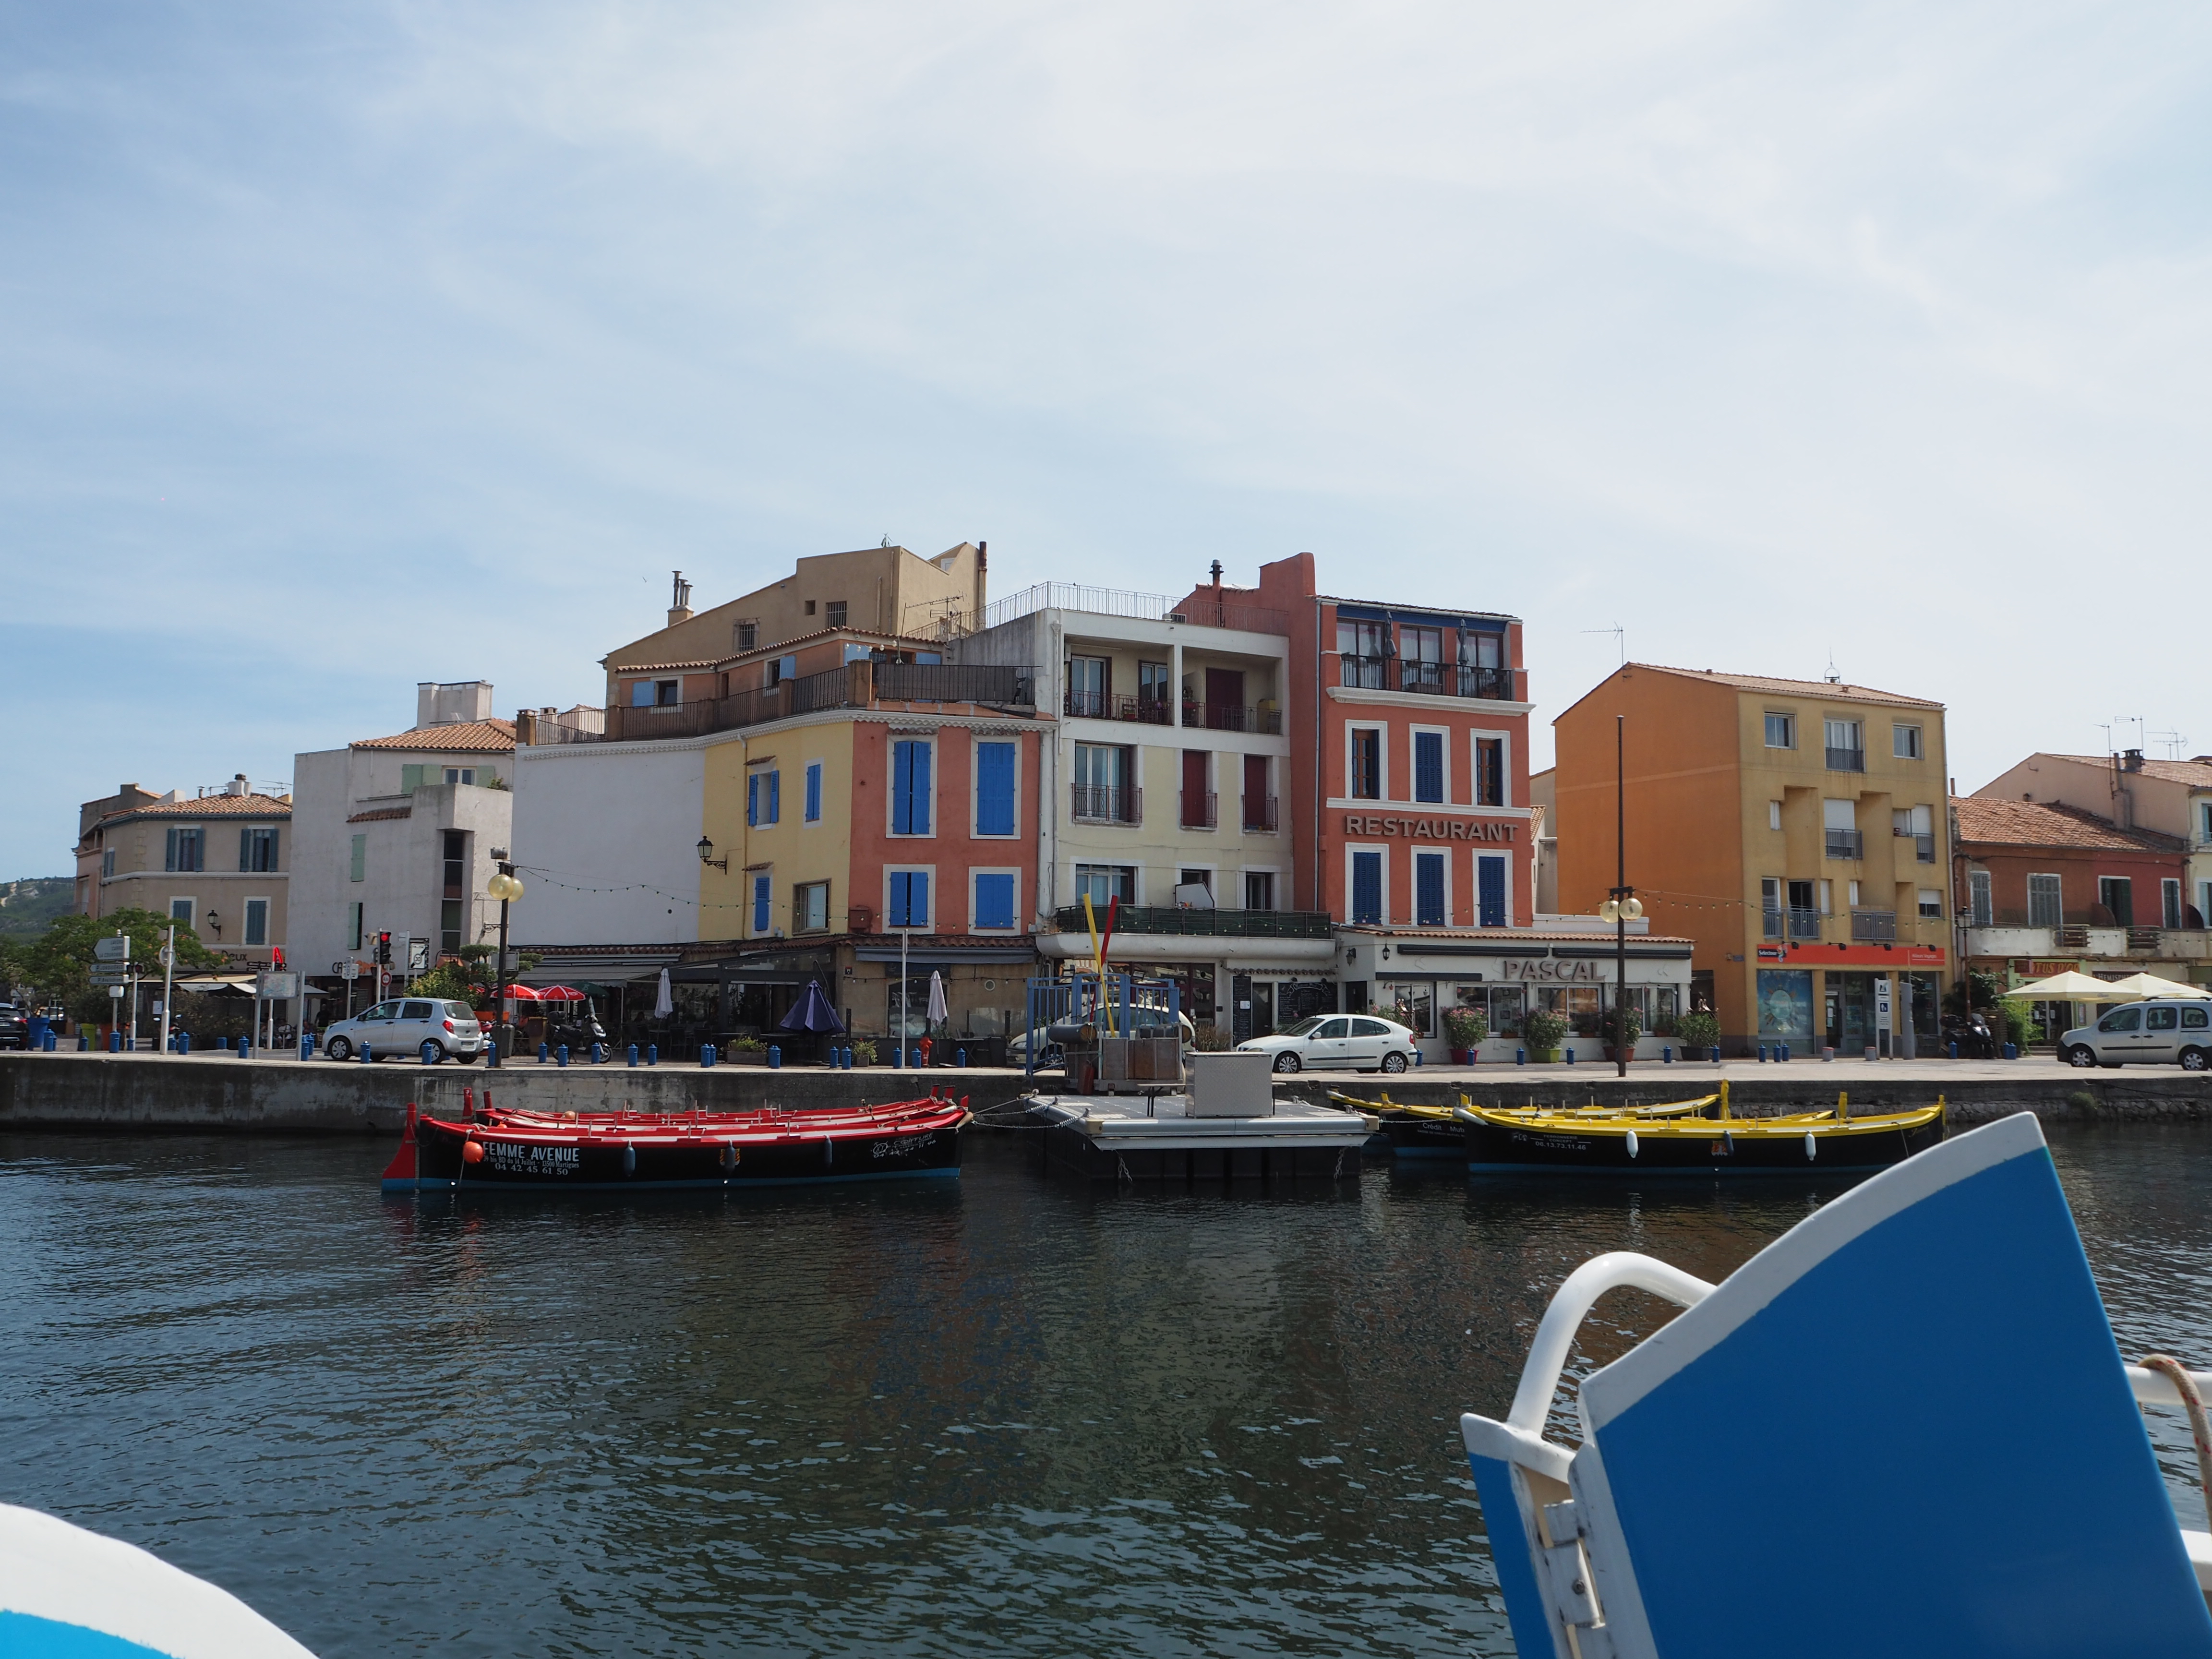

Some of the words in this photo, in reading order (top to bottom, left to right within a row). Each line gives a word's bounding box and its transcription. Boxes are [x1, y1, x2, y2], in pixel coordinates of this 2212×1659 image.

[1346, 816, 1518, 841] RESTAURANT
[1504, 961, 1606, 981] PASCAL
[482, 1141, 526, 1158] FEMME
[530, 1146, 580, 1162] AVENUE
[1535, 1141, 1587, 1150] 06.13.73.11.46
[495, 1162, 507, 1170] 04
[511, 1164, 523, 1172] 42
[555, 1161, 580, 1169] Martigues
